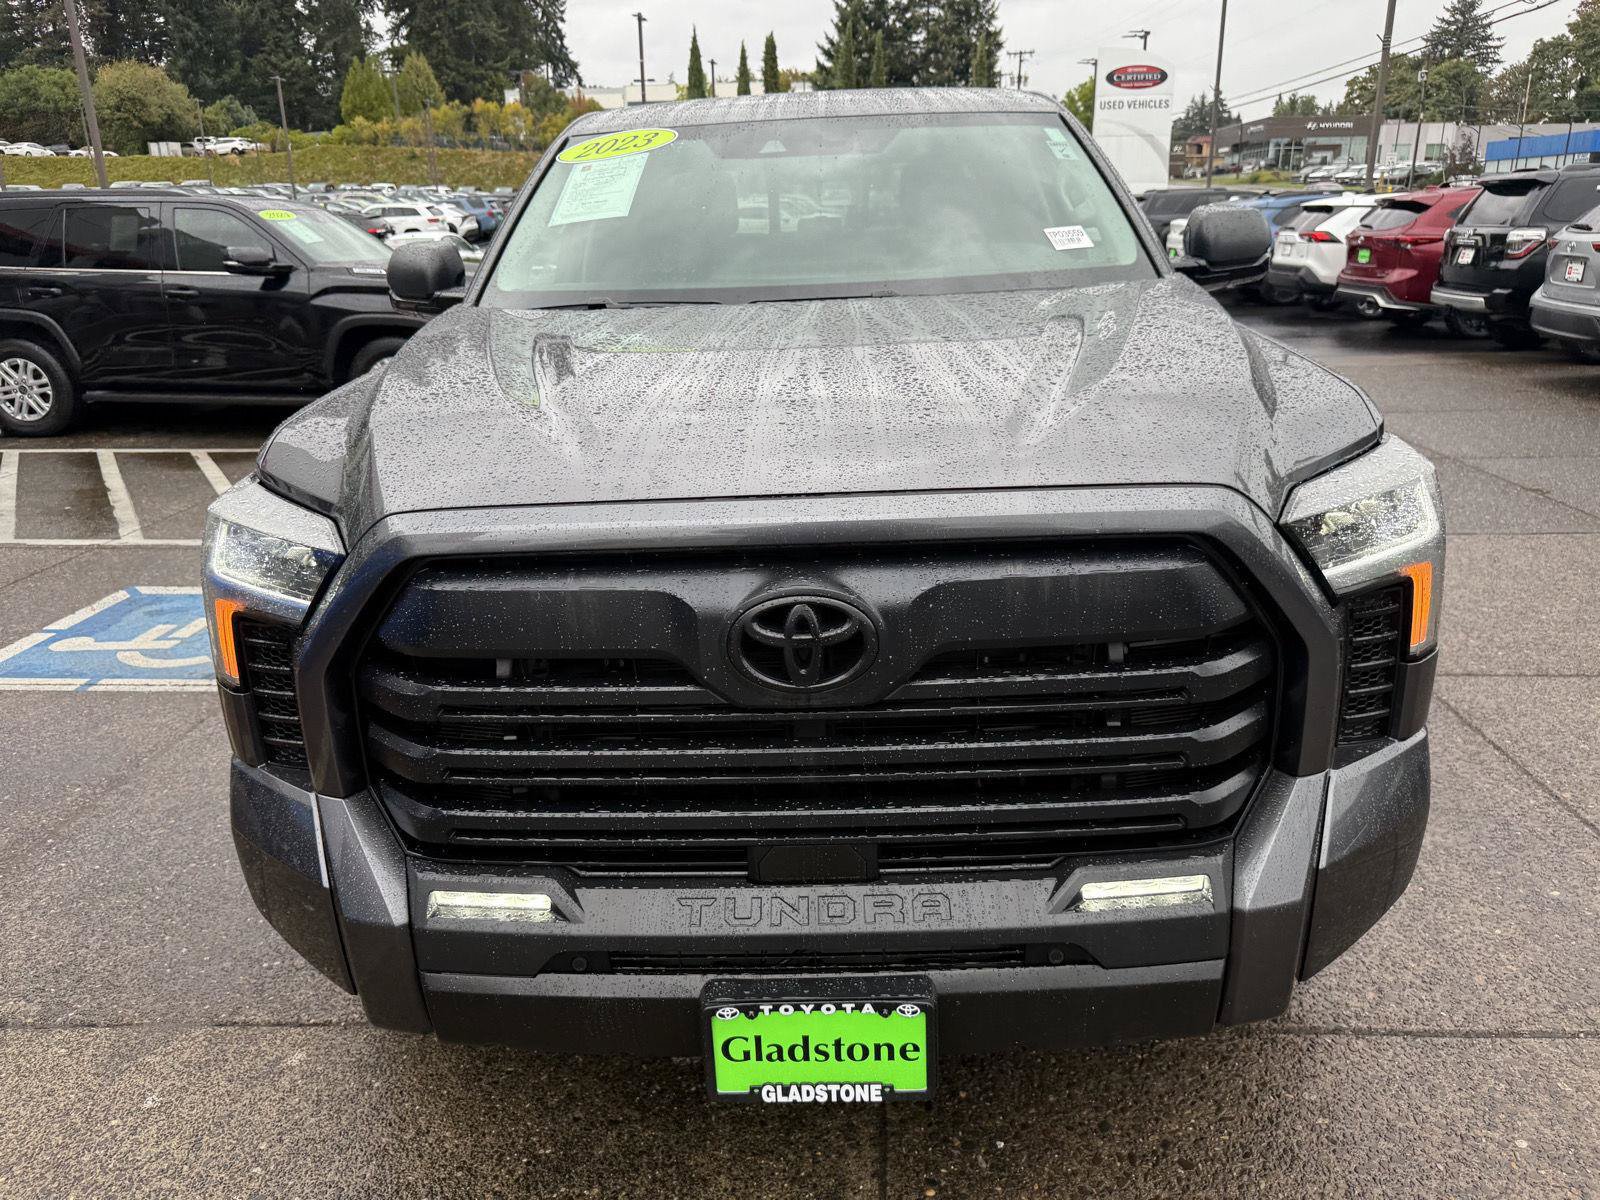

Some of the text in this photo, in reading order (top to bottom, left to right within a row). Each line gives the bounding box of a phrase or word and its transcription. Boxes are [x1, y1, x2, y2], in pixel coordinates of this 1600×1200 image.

[1099, 99, 1170, 110] USED VEHICLES
[574, 132, 659, 160] 2023
[677, 893, 952, 927] TUNDRA
[760, 1003, 877, 1016] TOYOTA
[720, 1034, 921, 1063] Gladstone
[761, 1084, 883, 1103] GLADSTONE
